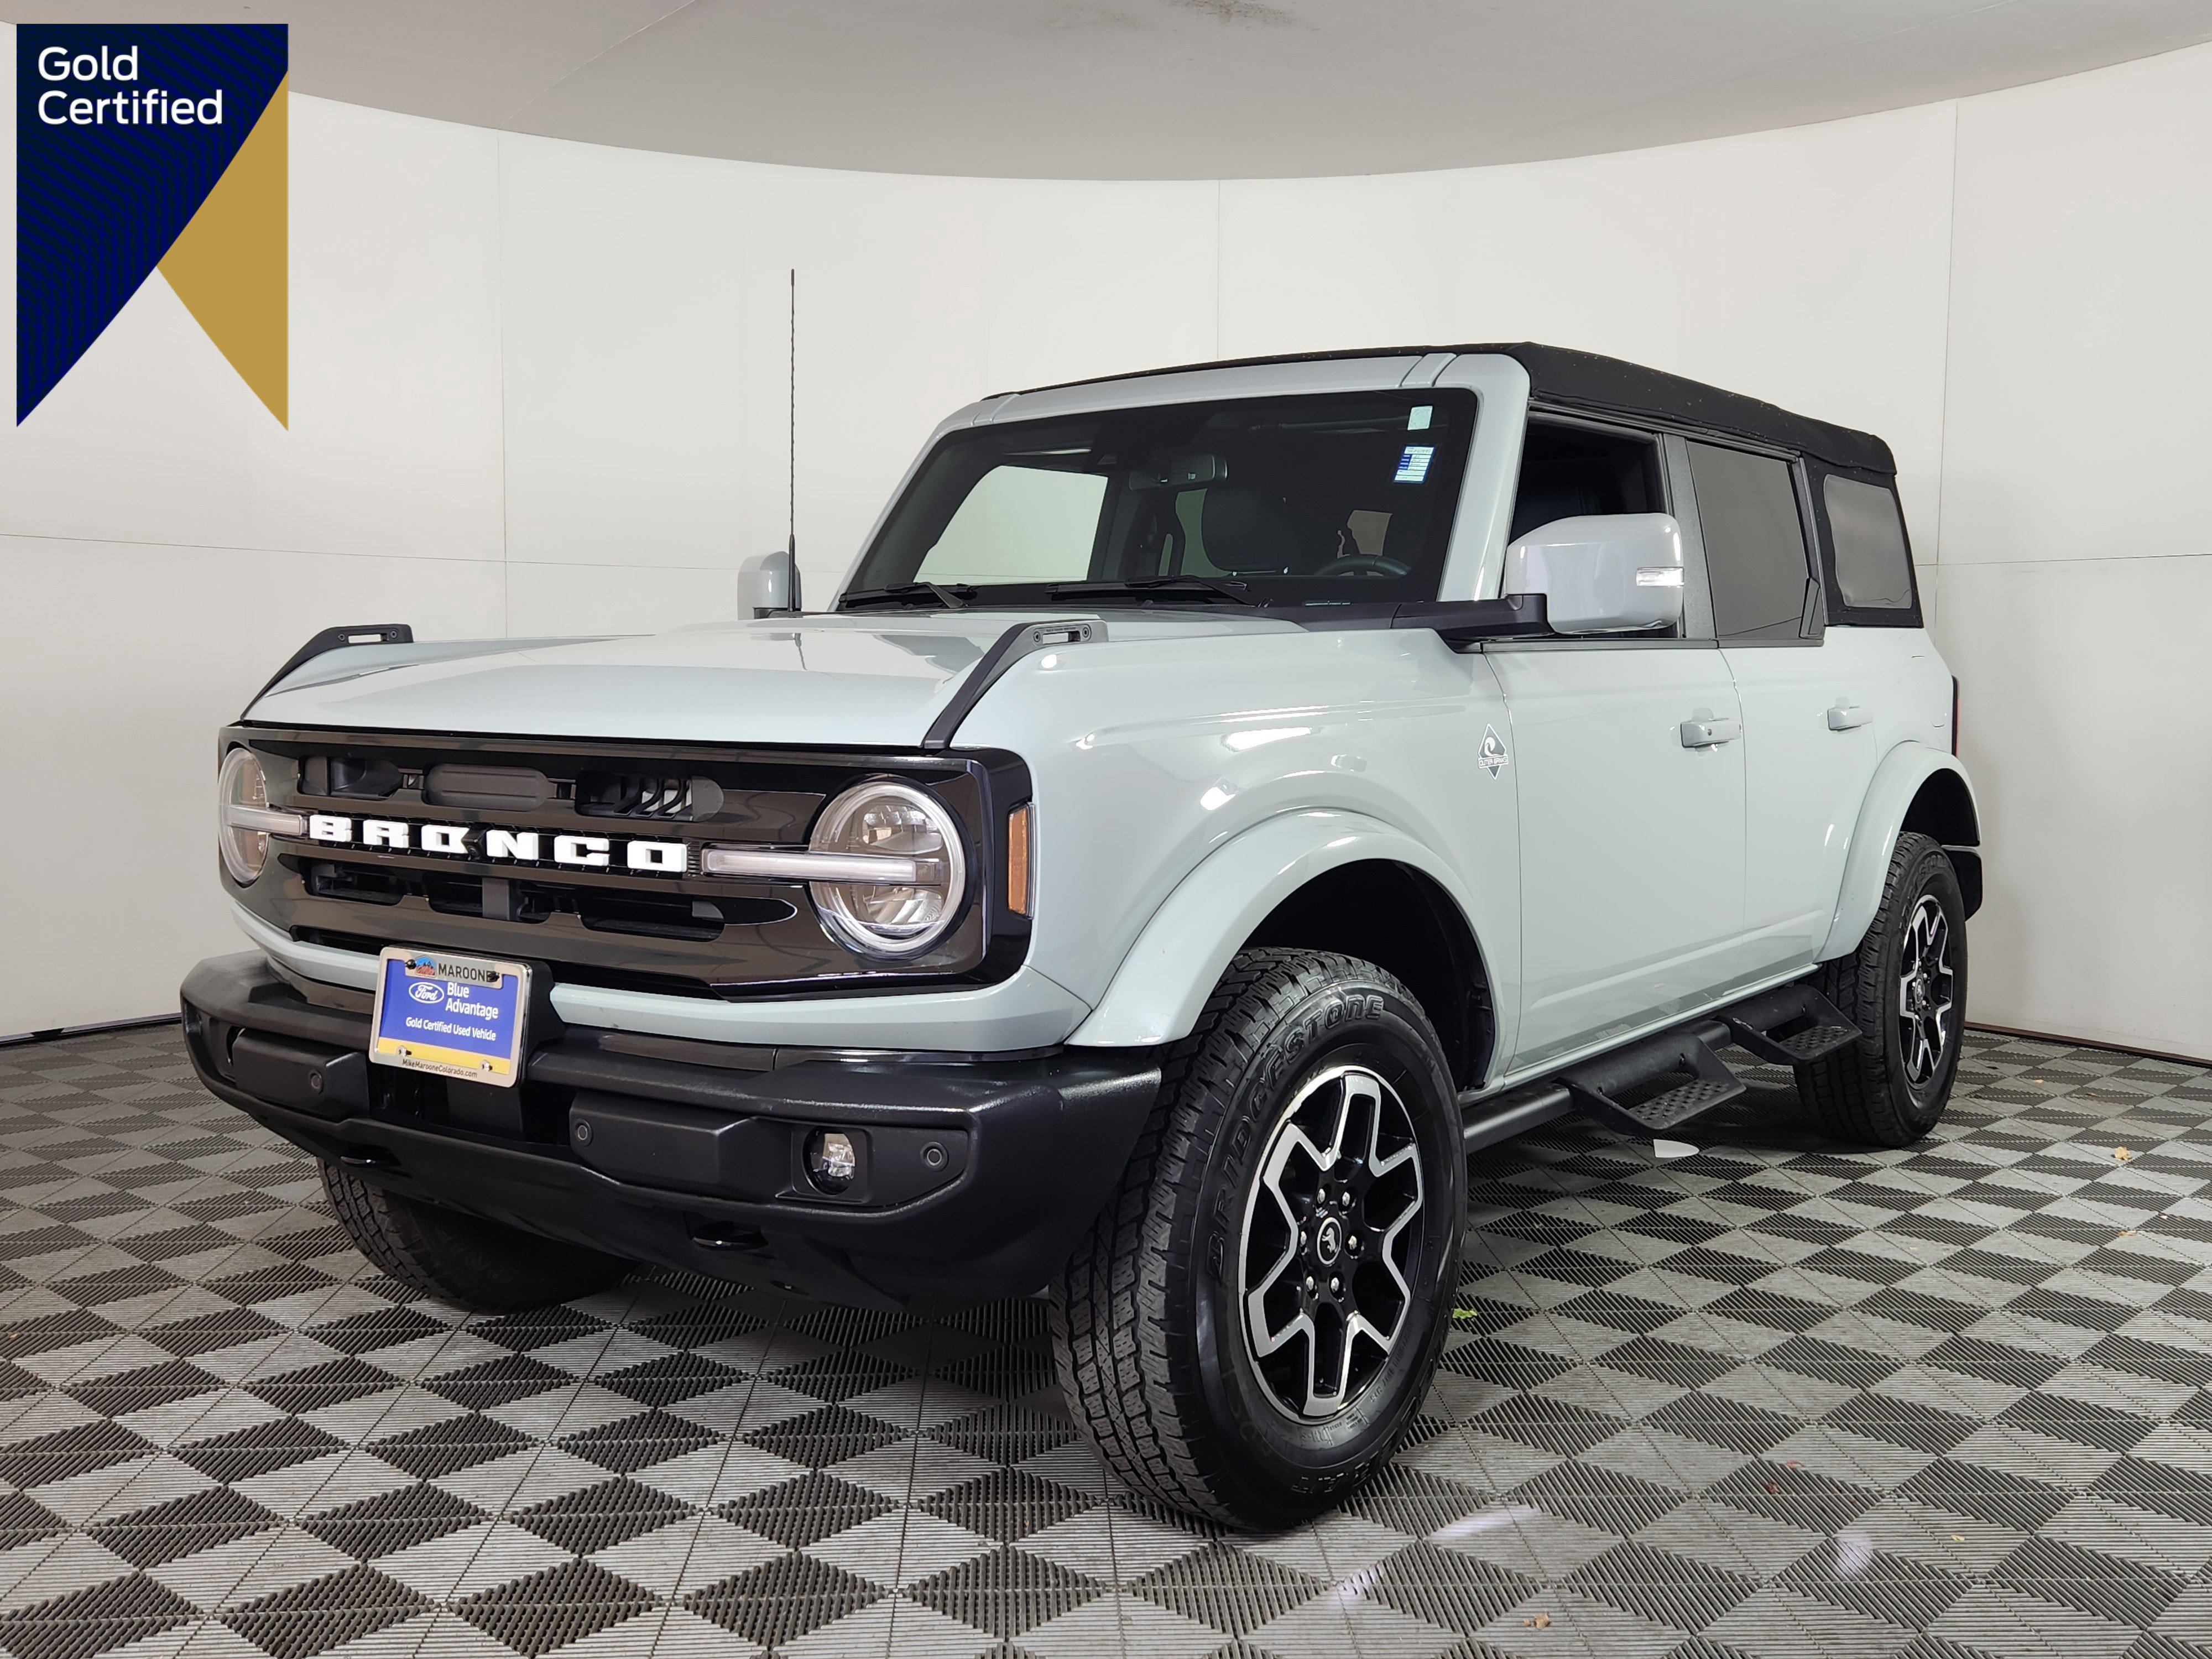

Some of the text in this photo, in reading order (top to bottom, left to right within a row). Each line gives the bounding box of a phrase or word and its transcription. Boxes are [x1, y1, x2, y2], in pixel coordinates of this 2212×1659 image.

[309, 814, 688, 872] BRONCO
[415, 984, 439, 1001] Ford
[447, 982, 469, 998] Blue
[445, 998, 498, 1020] Advantage
[405, 1016, 496, 1041] Gold Certified Used Vehicle
[402, 1058, 477, 1078] MikeMarooneColorado.com
[1206, 993, 1385, 1280] BRIDGESTONE
